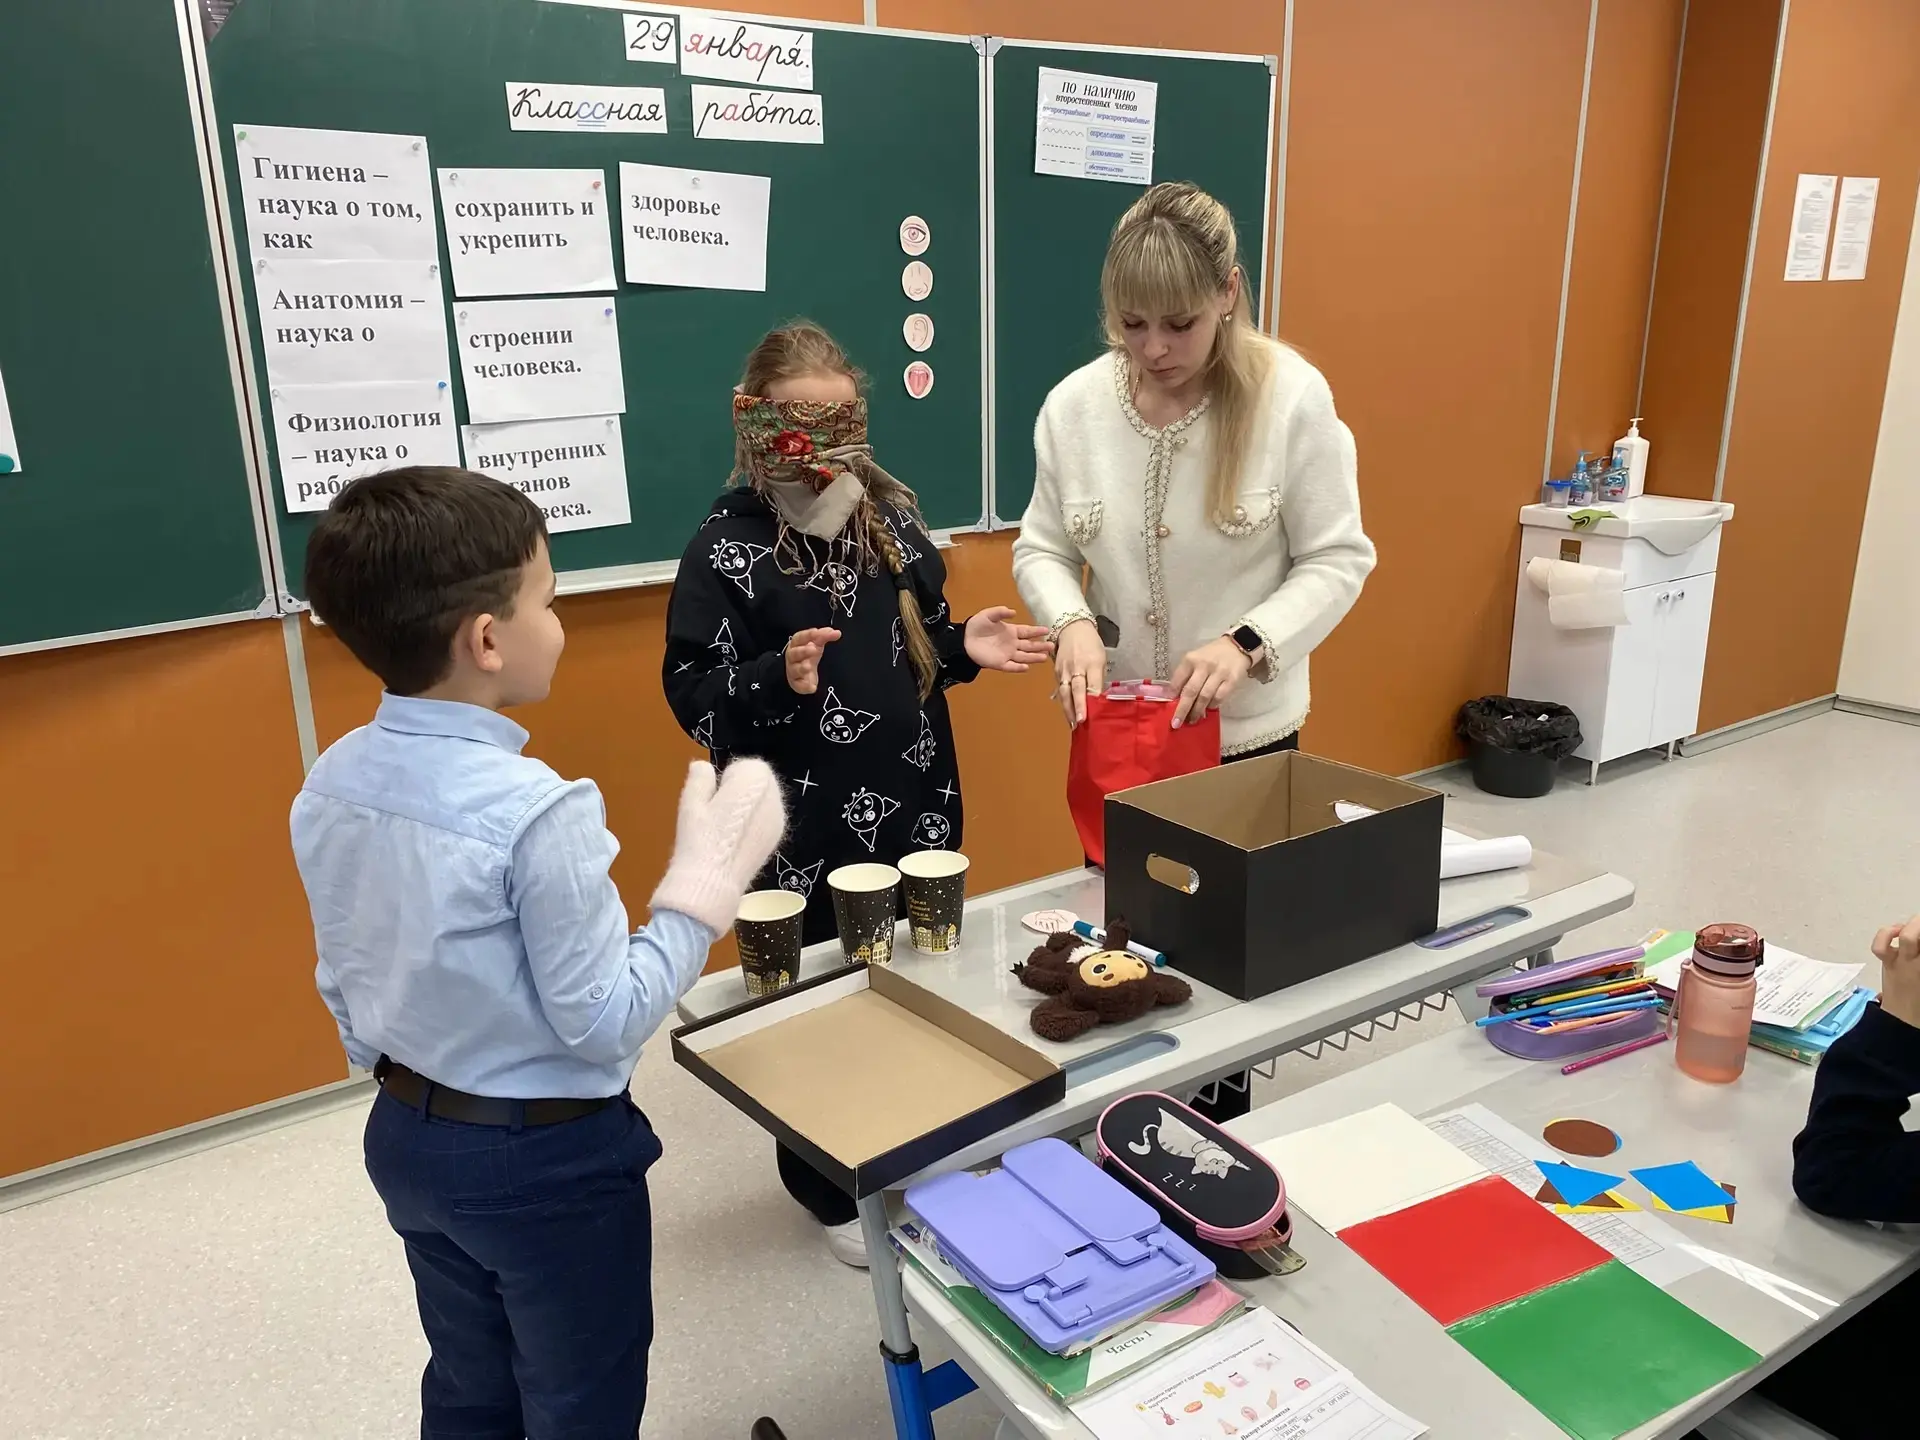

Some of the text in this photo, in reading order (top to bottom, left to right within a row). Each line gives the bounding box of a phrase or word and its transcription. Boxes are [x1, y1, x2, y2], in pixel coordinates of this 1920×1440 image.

[631, 19, 673, 50] 29
[512, 88, 663, 121] Классная
[1055, 95, 1138, 111] второстепенных членов
[253, 157, 366, 184] Гигиена
[258, 196, 423, 223] наука о том,
[454, 199, 594, 222] сохранить и
[631, 194, 721, 217] здоровье
[263, 229, 313, 250] как
[459, 231, 568, 255] укрепить
[633, 224, 729, 247] человека.
[273, 290, 404, 312] Анатомия
[277, 324, 375, 348] наука о
[469, 329, 573, 352] строении
[474, 359, 582, 379] человека.
[288, 410, 441, 434] Физиология
[314, 446, 389, 468] наука
[396, 444, 409, 460] о
[478, 443, 607, 471] внутренних
[509, 475, 571, 494] ганов
[541, 502, 592, 520] века.
[1105, 1336, 1145, 1354] Часть
[1241, 1407, 1289, 1440] Паспорт исследователя
[1281, 1424, 1299, 1437] УЗНАТЬ
[1328, 1390, 1349, 1405] ОРГАНАХ
[1275, 1423, 1286, 1431] Меня
